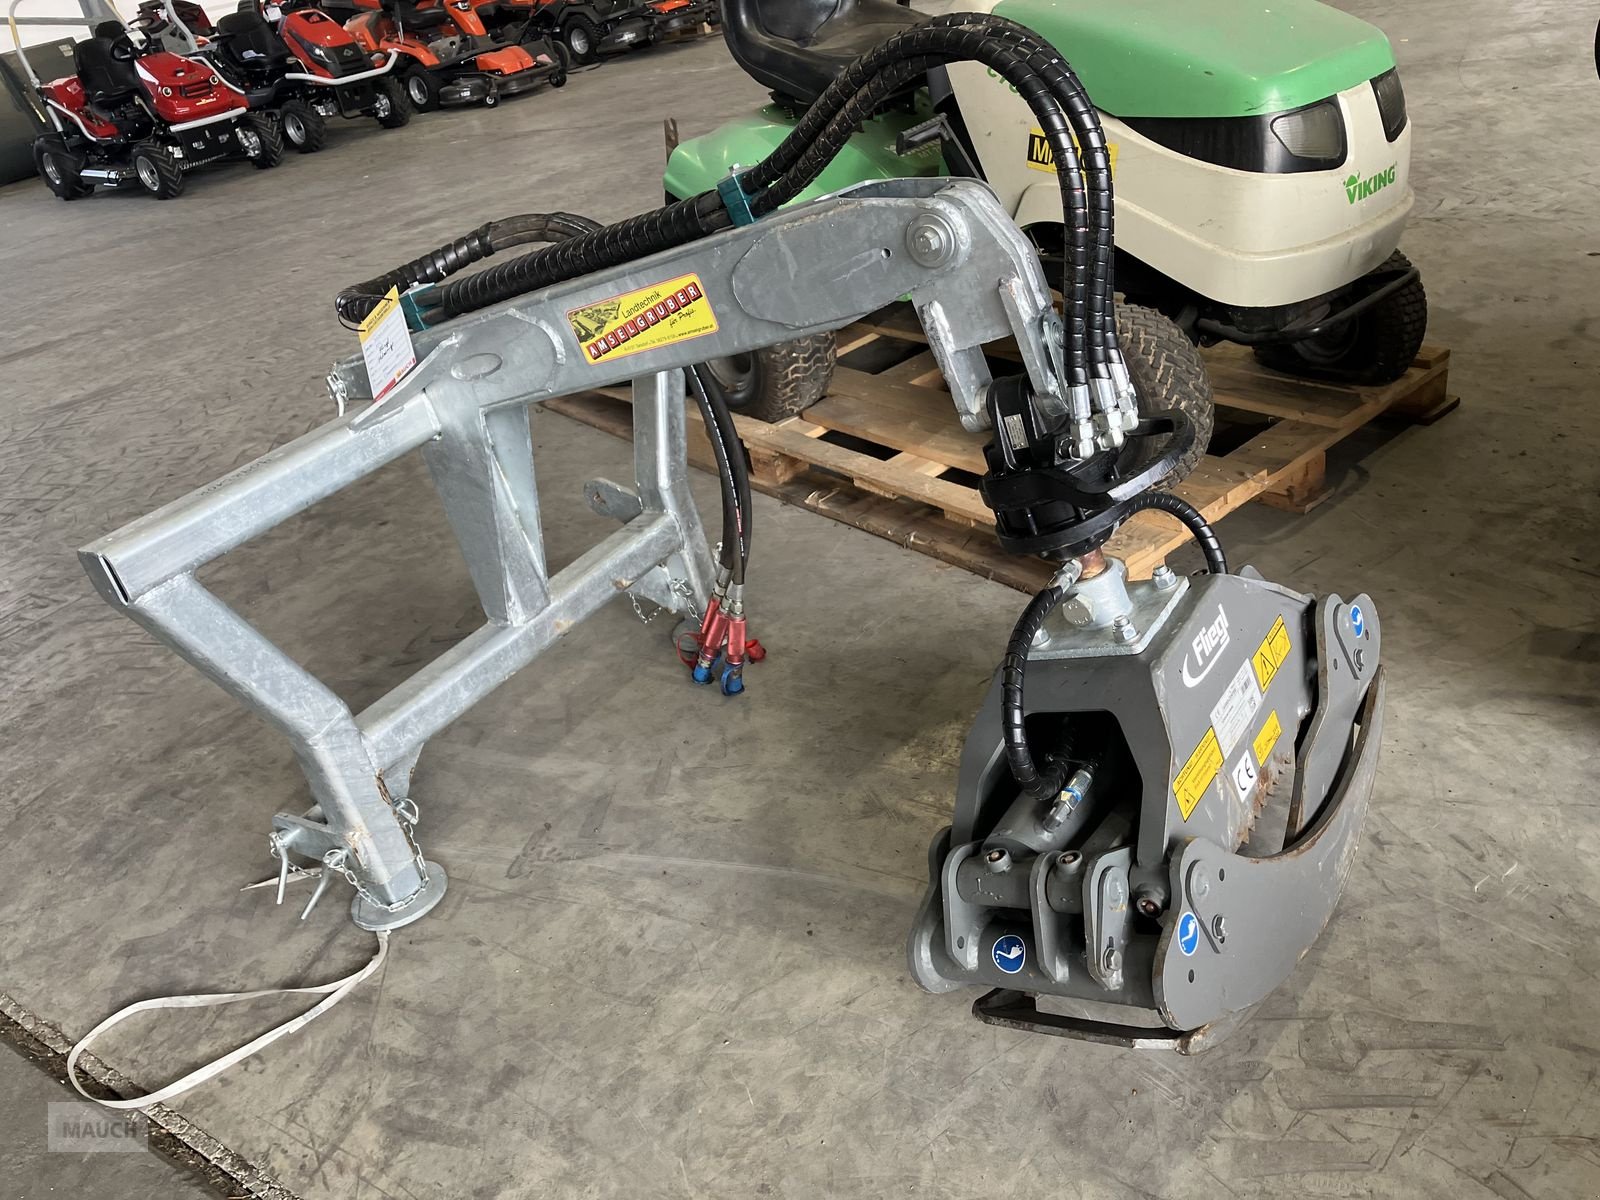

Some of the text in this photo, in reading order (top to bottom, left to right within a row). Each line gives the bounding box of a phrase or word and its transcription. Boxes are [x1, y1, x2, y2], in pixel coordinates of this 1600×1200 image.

[1345, 165, 1396, 205] VIKING
[588, 284, 700, 358] AMSELGRUBER
[621, 290, 662, 319] Landtechnik
[1191, 603, 1230, 667] Fliegl
